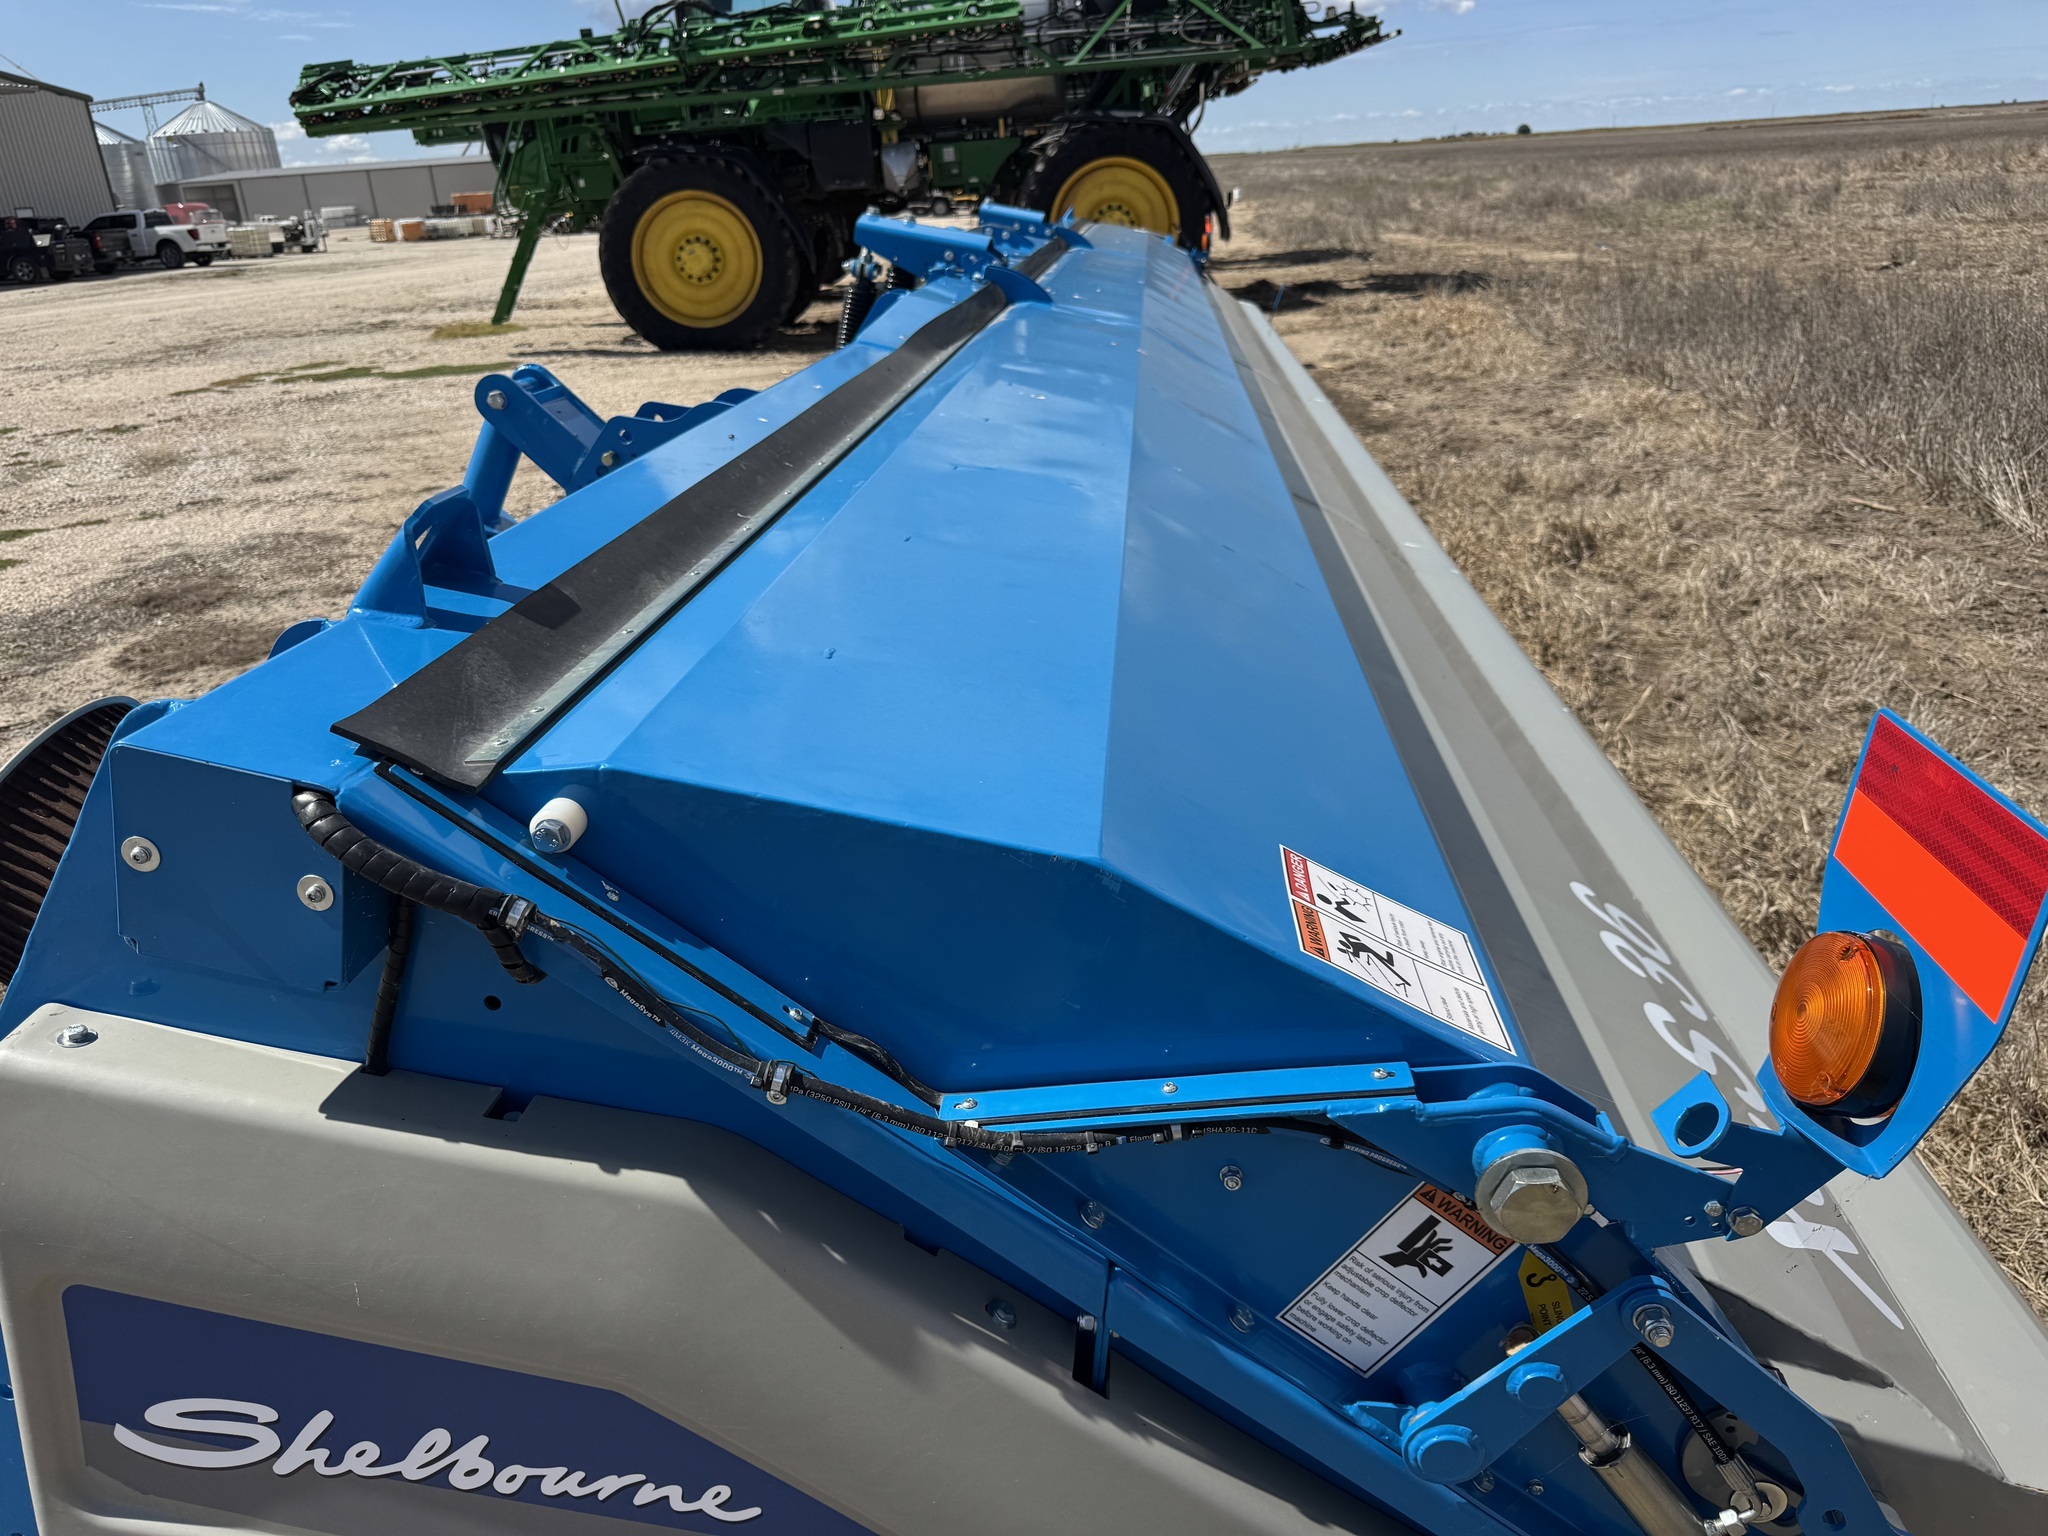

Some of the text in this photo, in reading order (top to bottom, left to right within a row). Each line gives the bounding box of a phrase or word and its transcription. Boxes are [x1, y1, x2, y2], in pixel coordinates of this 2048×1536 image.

[1290, 853, 1308, 892] DANGER
[1301, 904, 1322, 946] WARNING
[670, 1028, 691, 1048] 4M3K
[805, 1089, 832, 1104] (3250
[833, 1098, 851, 1110] PSI)
[871, 1111, 889, 1122] (6.3
[889, 1119, 910, 1130] mm)
[911, 1123, 926, 1134] ISO
[980, 1143, 996, 1151] SAE
[1055, 1145, 1082, 1153] 18752
[1344, 1144, 1369, 1156] WERING
[1437, 1196, 1508, 1250] WARNING
[1322, 1281, 1378, 1320] Keep hands clear
[1333, 1270, 1371, 1297] mechanism
[1341, 1264, 1418, 1317] adjustable crop deflector
[1349, 1255, 1364, 1269] Risk
[1371, 1272, 1396, 1290] serious
[1395, 1288, 1414, 1303] injury
[1413, 1300, 1429, 1313] from
[1578, 1287, 1594, 1301] 22.5
[1289, 1312, 1317, 1333] machine
[1296, 1305, 1352, 1345] before working on
[1311, 1291, 1389, 1346] Fully lower crop deflector
[1311, 1305, 1336, 1323] engage
[1335, 1321, 1356, 1336] safety
[1355, 1333, 1372, 1347] latch
[1538, 1304, 1552, 1326] POINT
[1665, 1383, 1677, 1398] ISO
[1673, 1395, 1693, 1415] 11237
[1690, 1415, 1704, 1429] R17
[1703, 1432, 1717, 1448] SAE
[112, 1398, 764, 1523] Shelbourne
